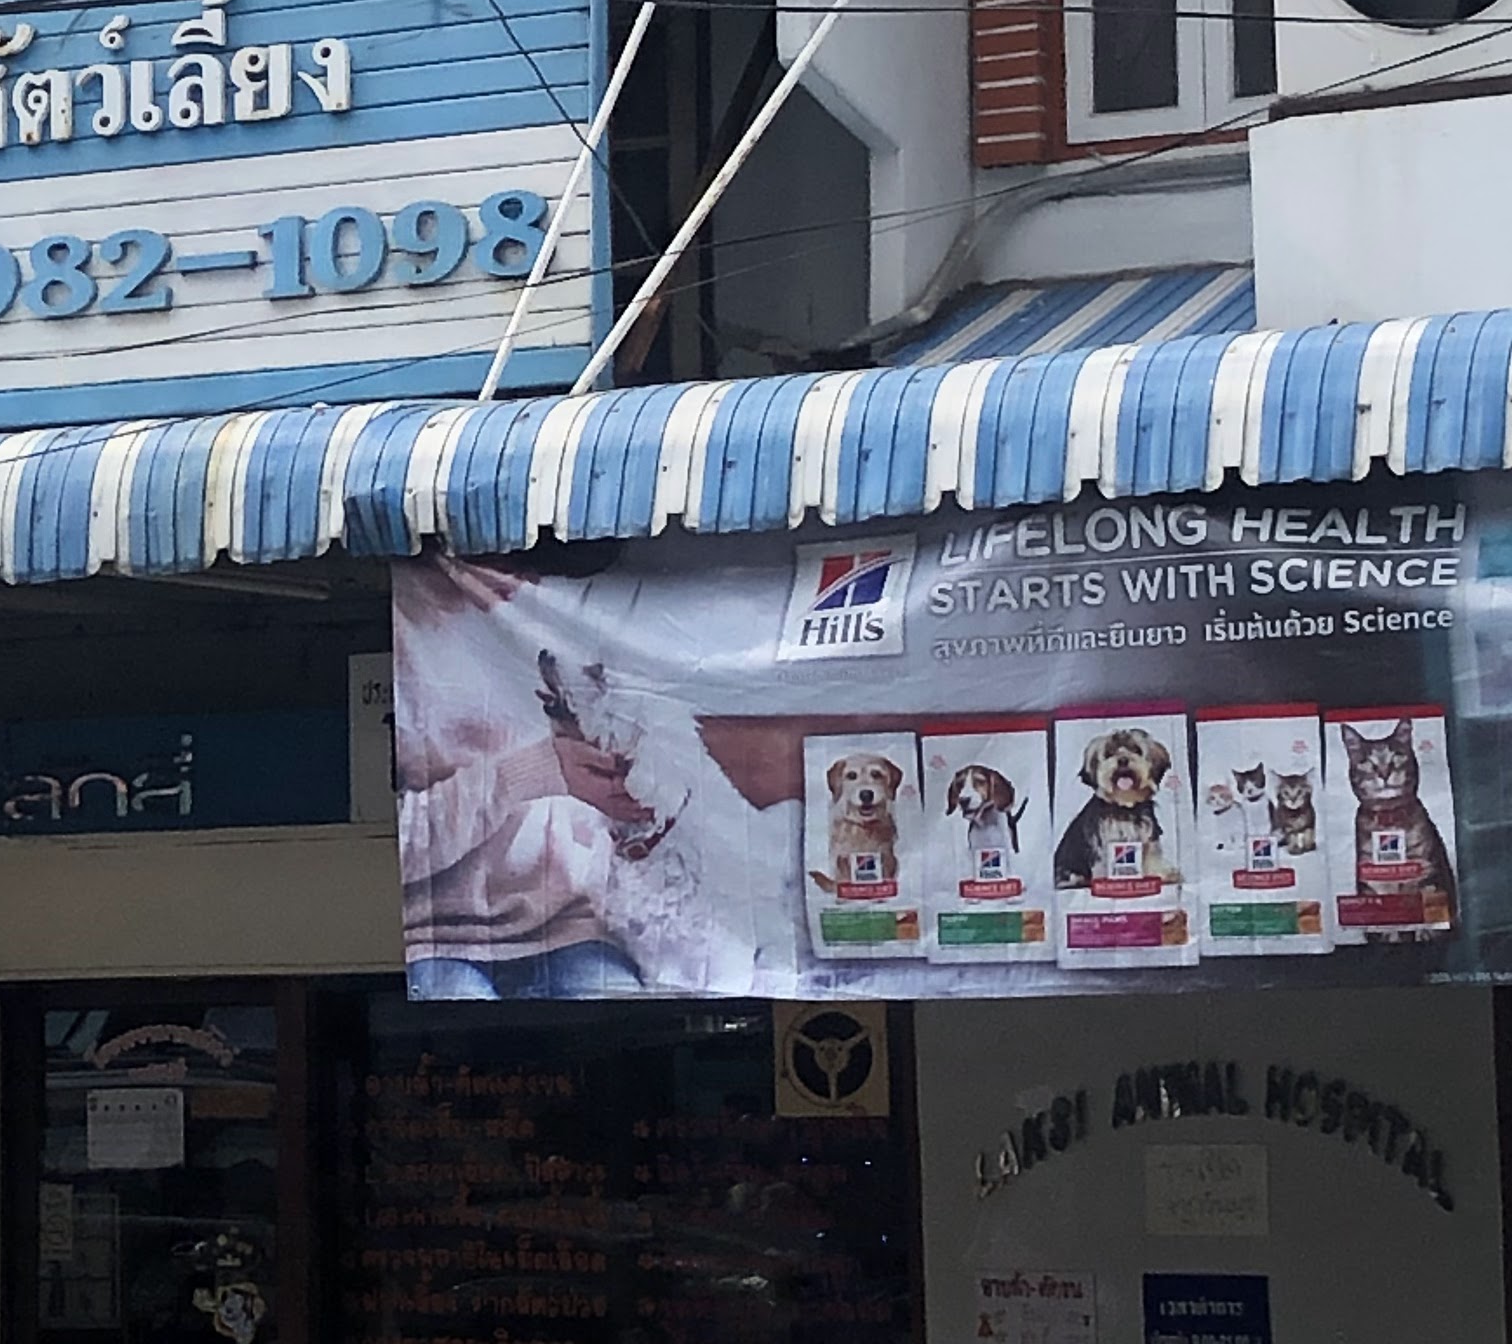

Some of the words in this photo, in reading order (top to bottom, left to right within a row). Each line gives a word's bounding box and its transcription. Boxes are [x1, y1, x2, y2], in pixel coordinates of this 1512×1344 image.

[941, 501, 1207, 567] LIFELONG
[1231, 503, 1466, 544] HEALTH
[929, 572, 1106, 616] STARTS
[1121, 561, 1235, 604] WITH
[1250, 556, 1461, 595] SCIENCE
[799, 612, 885, 647] Hill's
[1205, 609, 1335, 642] เริ่มต้นด้วย
[1344, 606, 1455, 634] Science
